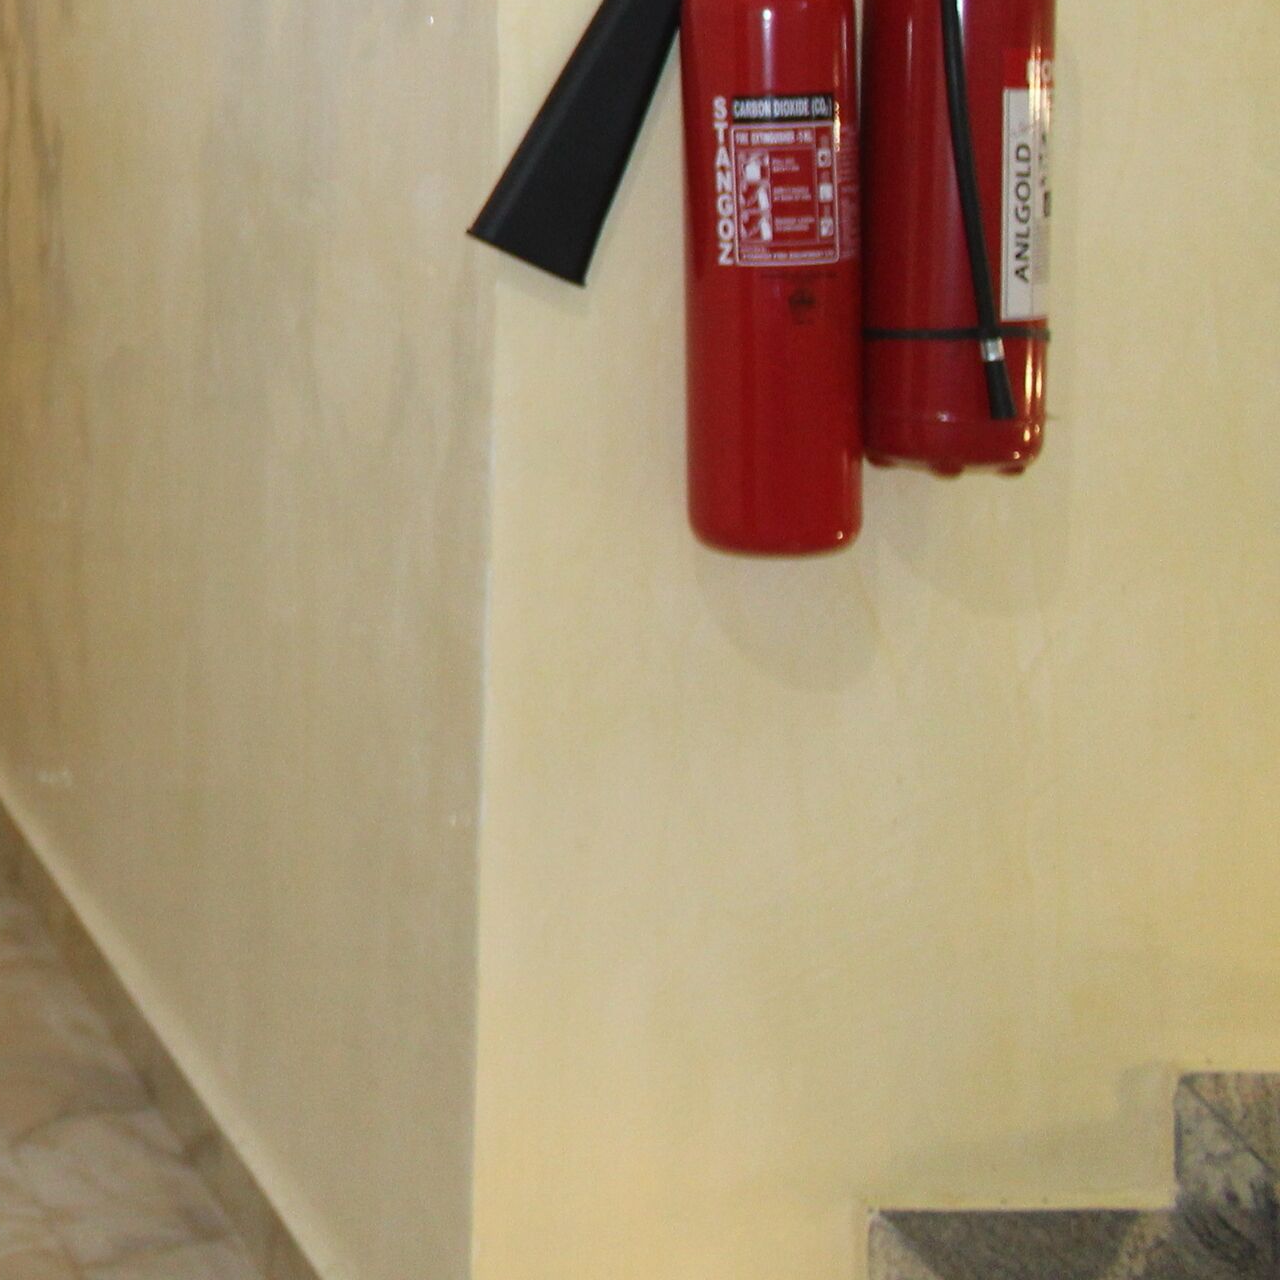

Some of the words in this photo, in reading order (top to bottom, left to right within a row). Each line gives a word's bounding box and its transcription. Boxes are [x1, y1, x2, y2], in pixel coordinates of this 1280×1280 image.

[733, 99, 772, 118] CARBON
[773, 97, 810, 117] DIOXIDE
[713, 96, 735, 266] STANGOZ
[1014, 142, 1032, 284] ANLGOLD
